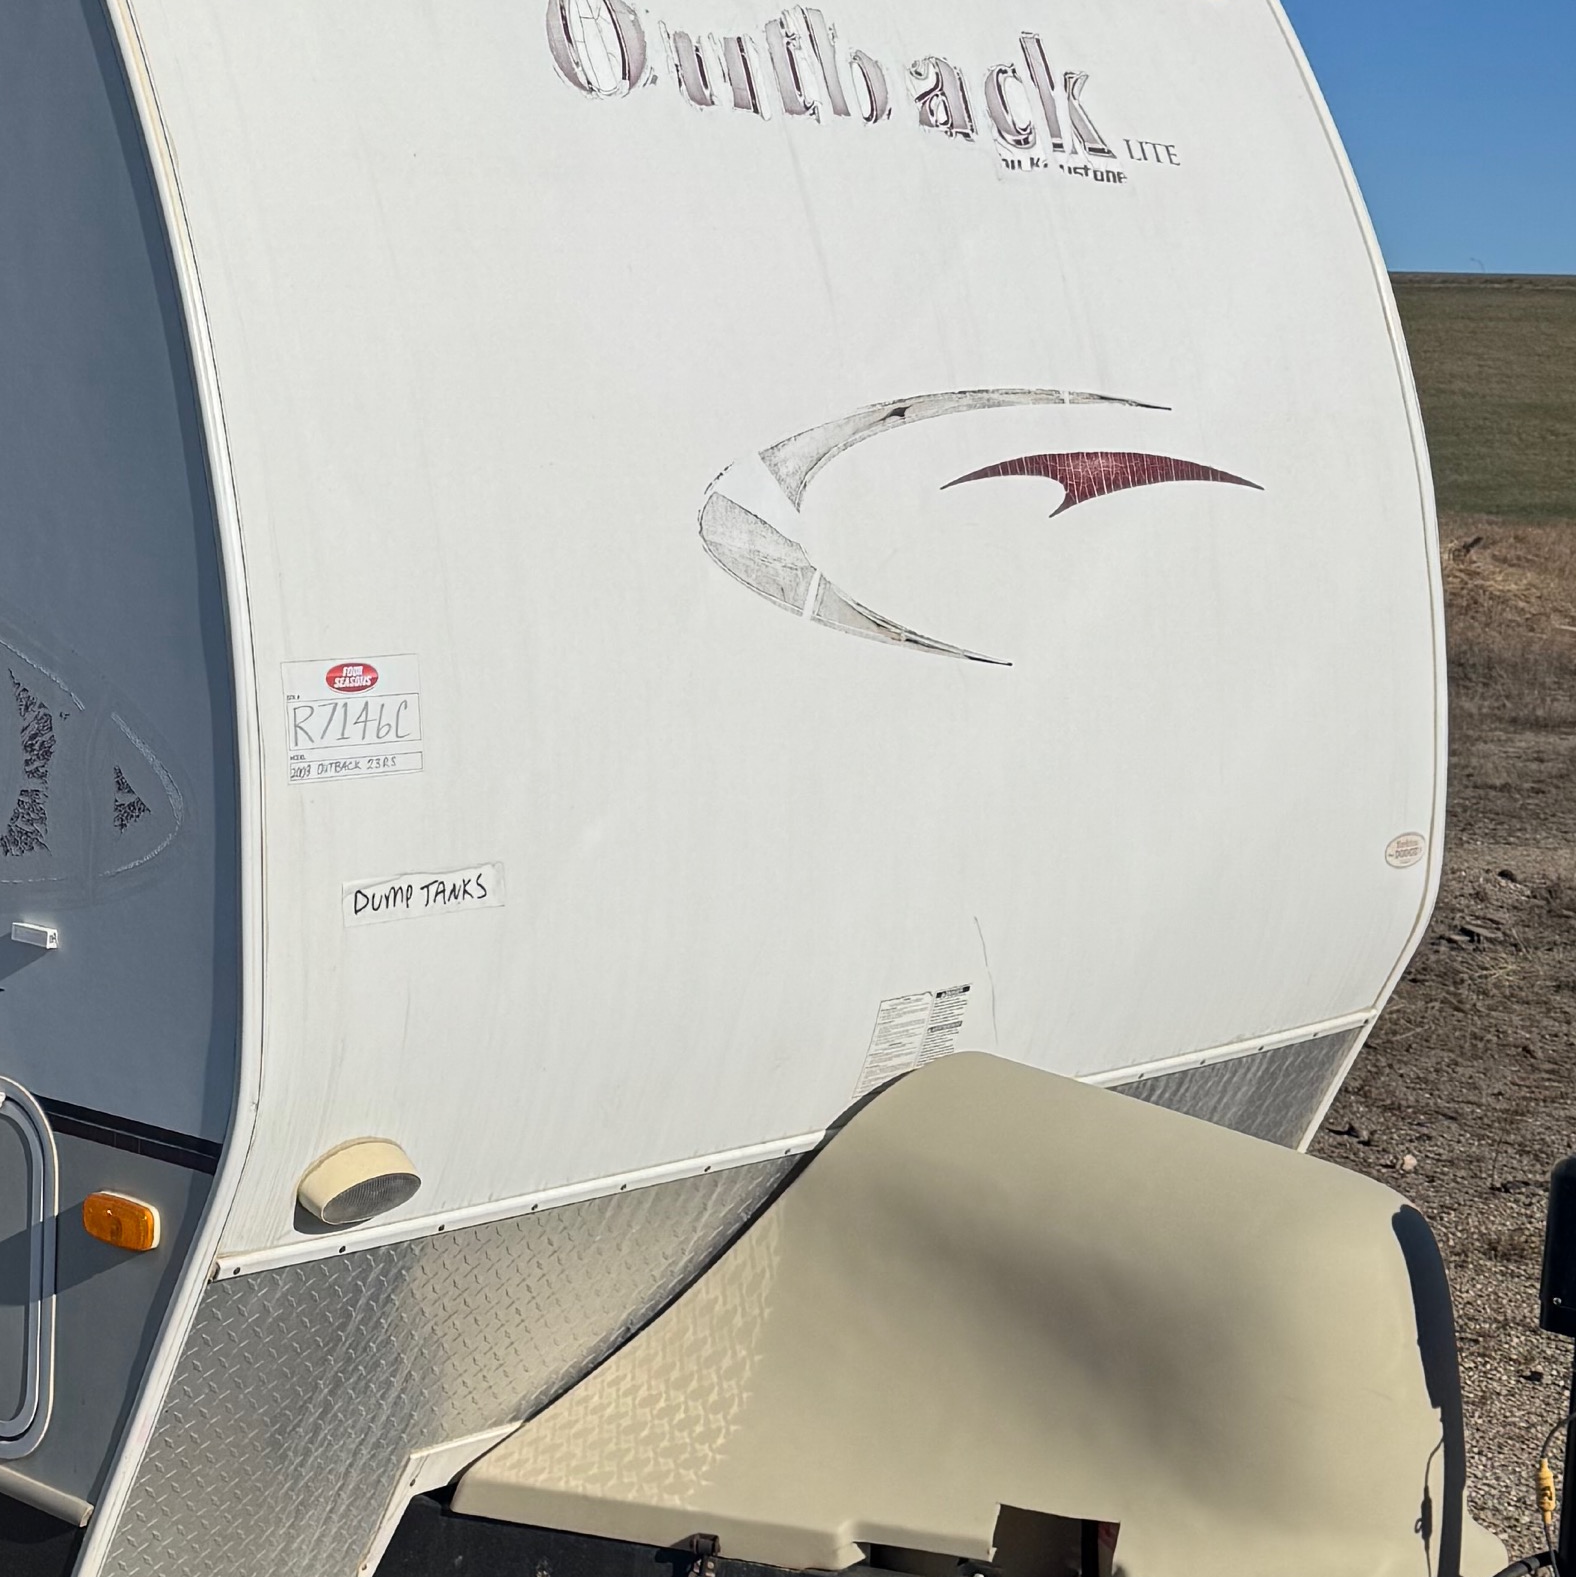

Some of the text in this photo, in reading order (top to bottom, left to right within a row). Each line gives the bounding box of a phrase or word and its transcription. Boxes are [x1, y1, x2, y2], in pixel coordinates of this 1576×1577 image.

[1123, 138, 1181, 167] LITE
[342, 665, 364, 677] FOUR
[333, 675, 372, 689] SEASONS
[292, 699, 412, 747] R7146C
[366, 756, 397, 770] 23RS
[353, 873, 487, 915] DUMP TANKS
